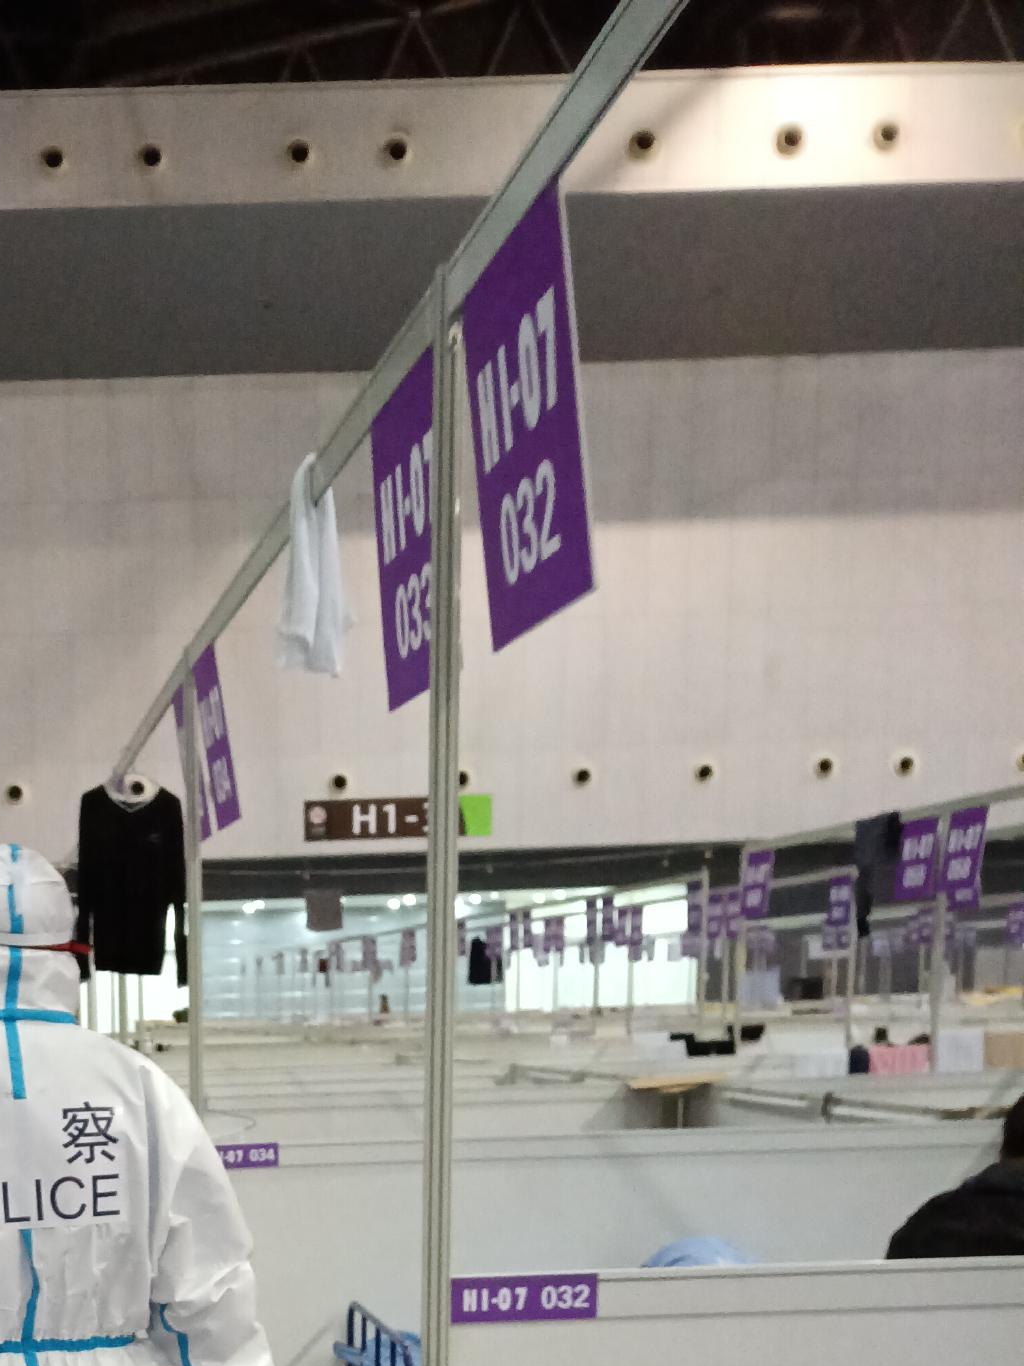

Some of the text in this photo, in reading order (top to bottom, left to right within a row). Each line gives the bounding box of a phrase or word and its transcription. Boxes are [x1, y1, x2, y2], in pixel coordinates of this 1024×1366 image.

[500, 459, 561, 585] 032
[352, 803, 429, 835] H1-
[540, 1284, 591, 1310] 032
